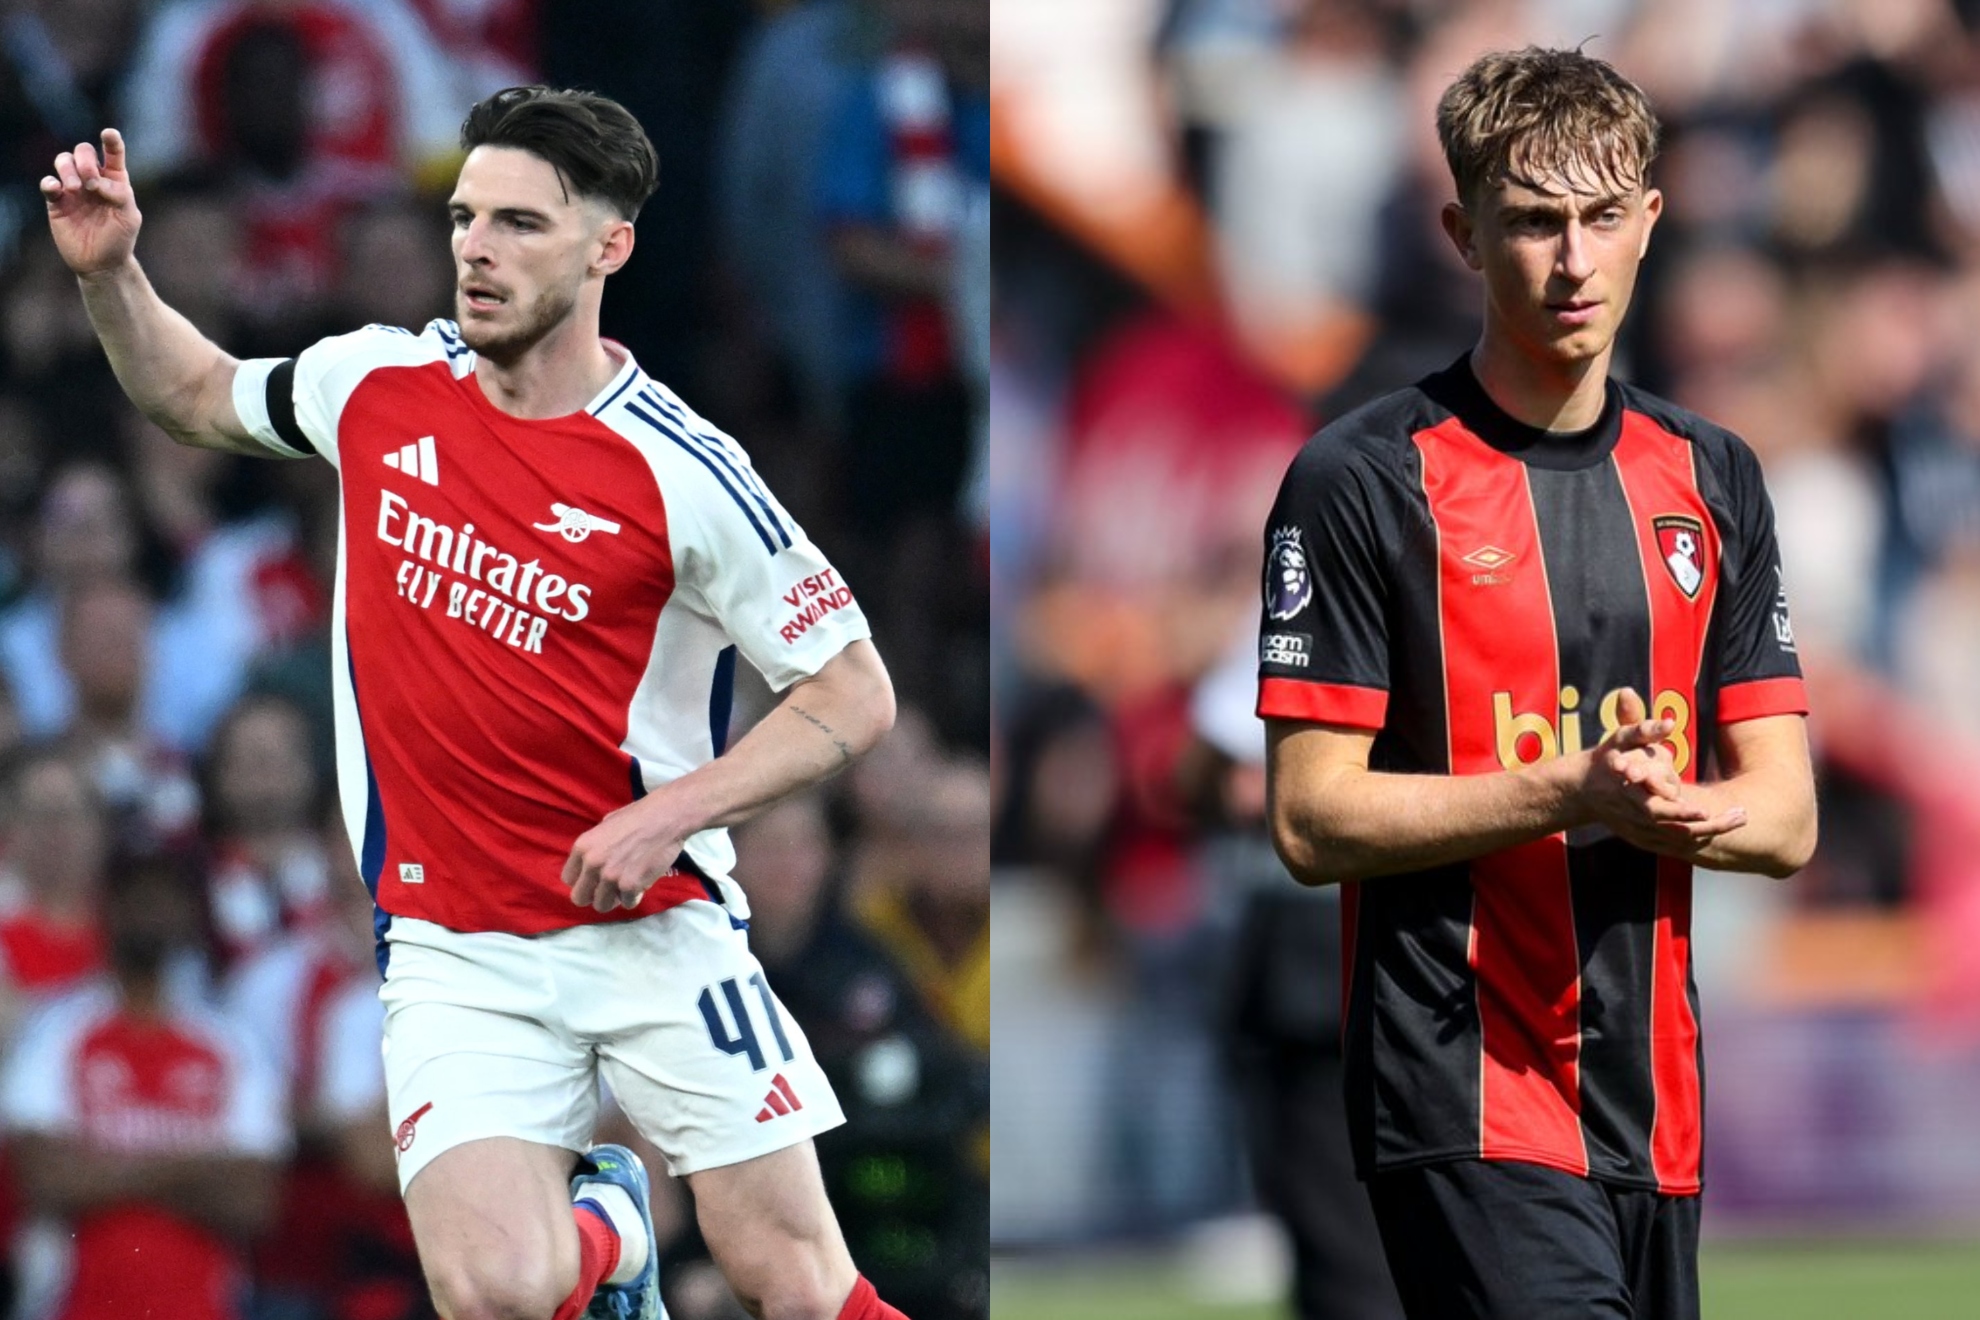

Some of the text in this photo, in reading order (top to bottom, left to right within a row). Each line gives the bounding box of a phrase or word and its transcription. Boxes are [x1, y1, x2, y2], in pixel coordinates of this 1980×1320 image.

[377, 488, 592, 622] Emirates
[782, 568, 835, 608] VISIT
[396, 559, 548, 654] FLY BETTER
[779, 586, 854, 645] RWAND
[696, 971, 796, 1074] 41
